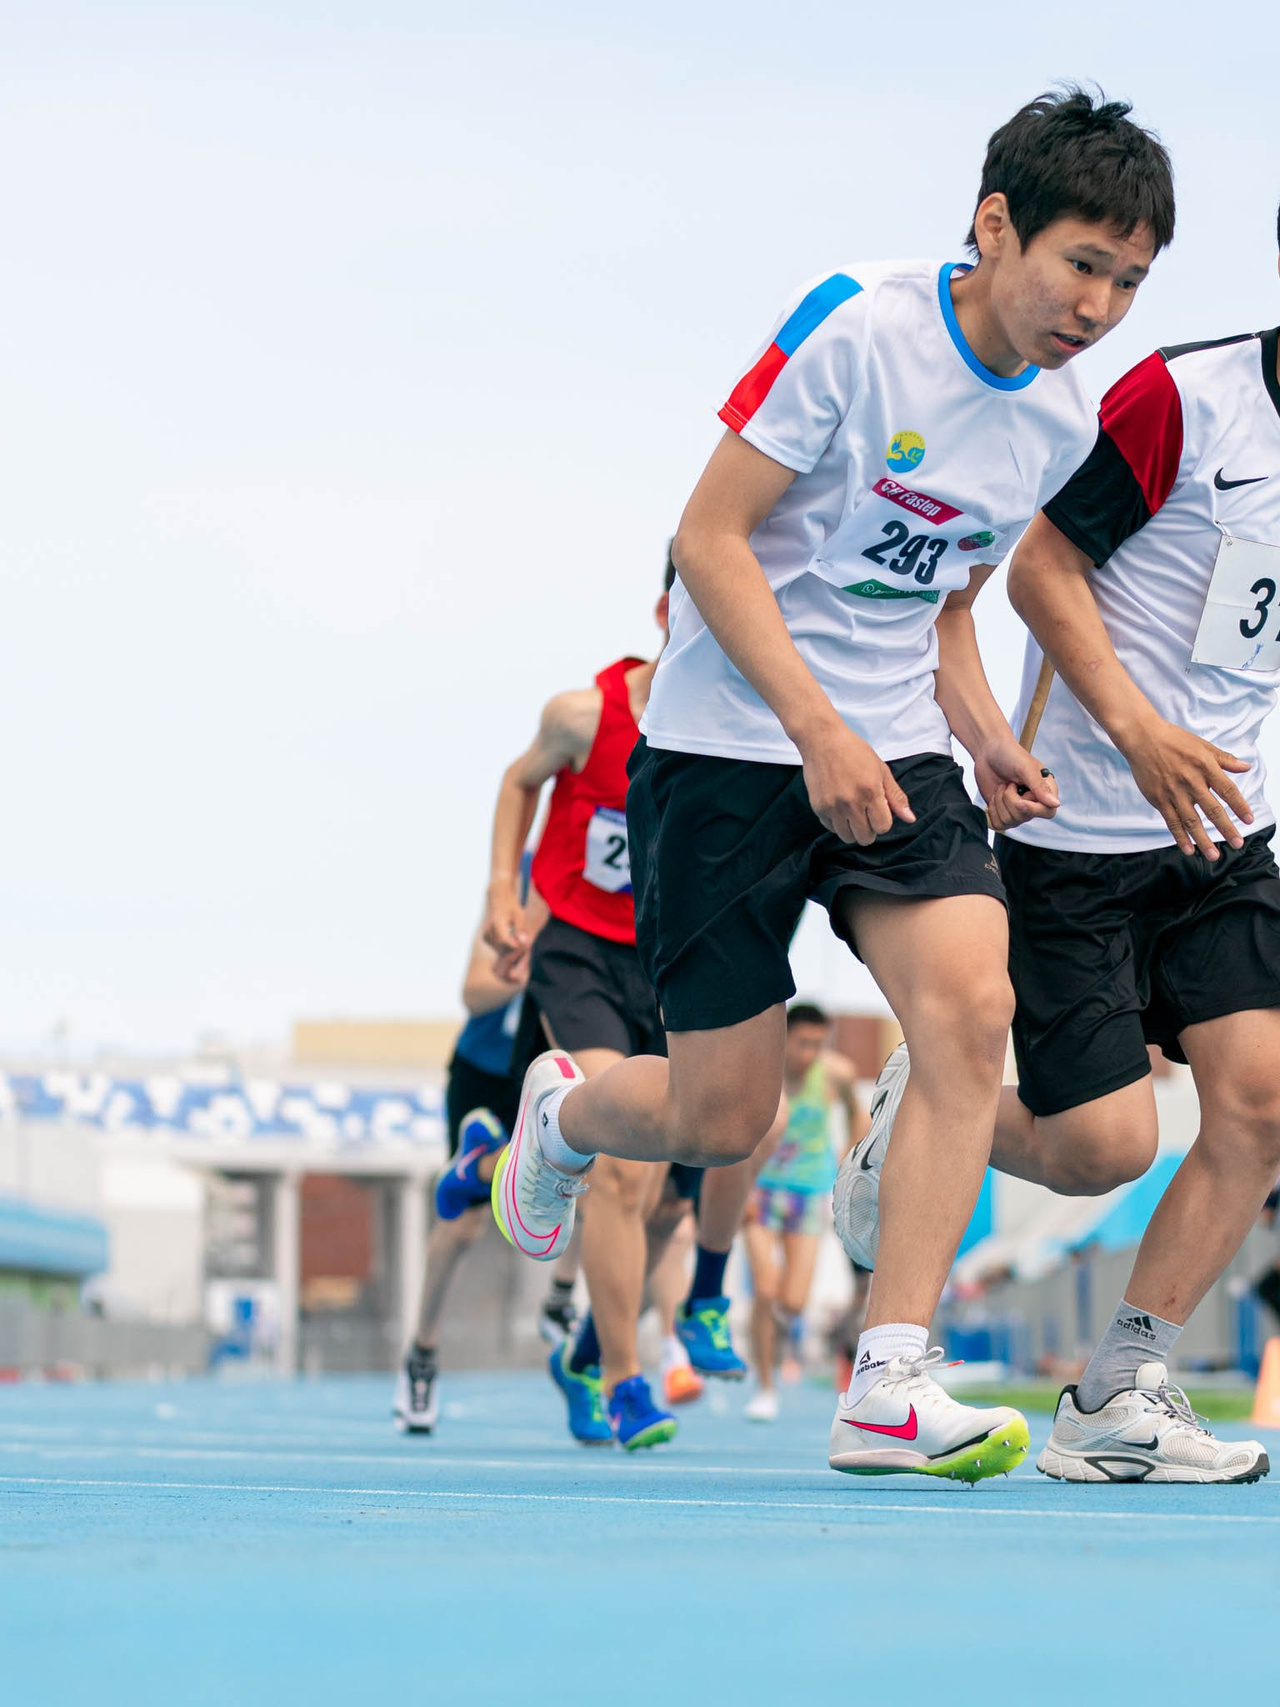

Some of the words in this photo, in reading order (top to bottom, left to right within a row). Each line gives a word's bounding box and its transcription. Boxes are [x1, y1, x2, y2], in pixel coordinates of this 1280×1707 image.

[898, 492, 942, 517] Fastep
[861, 520, 948, 585] 293
[1117, 1319, 1157, 1341] adidas
